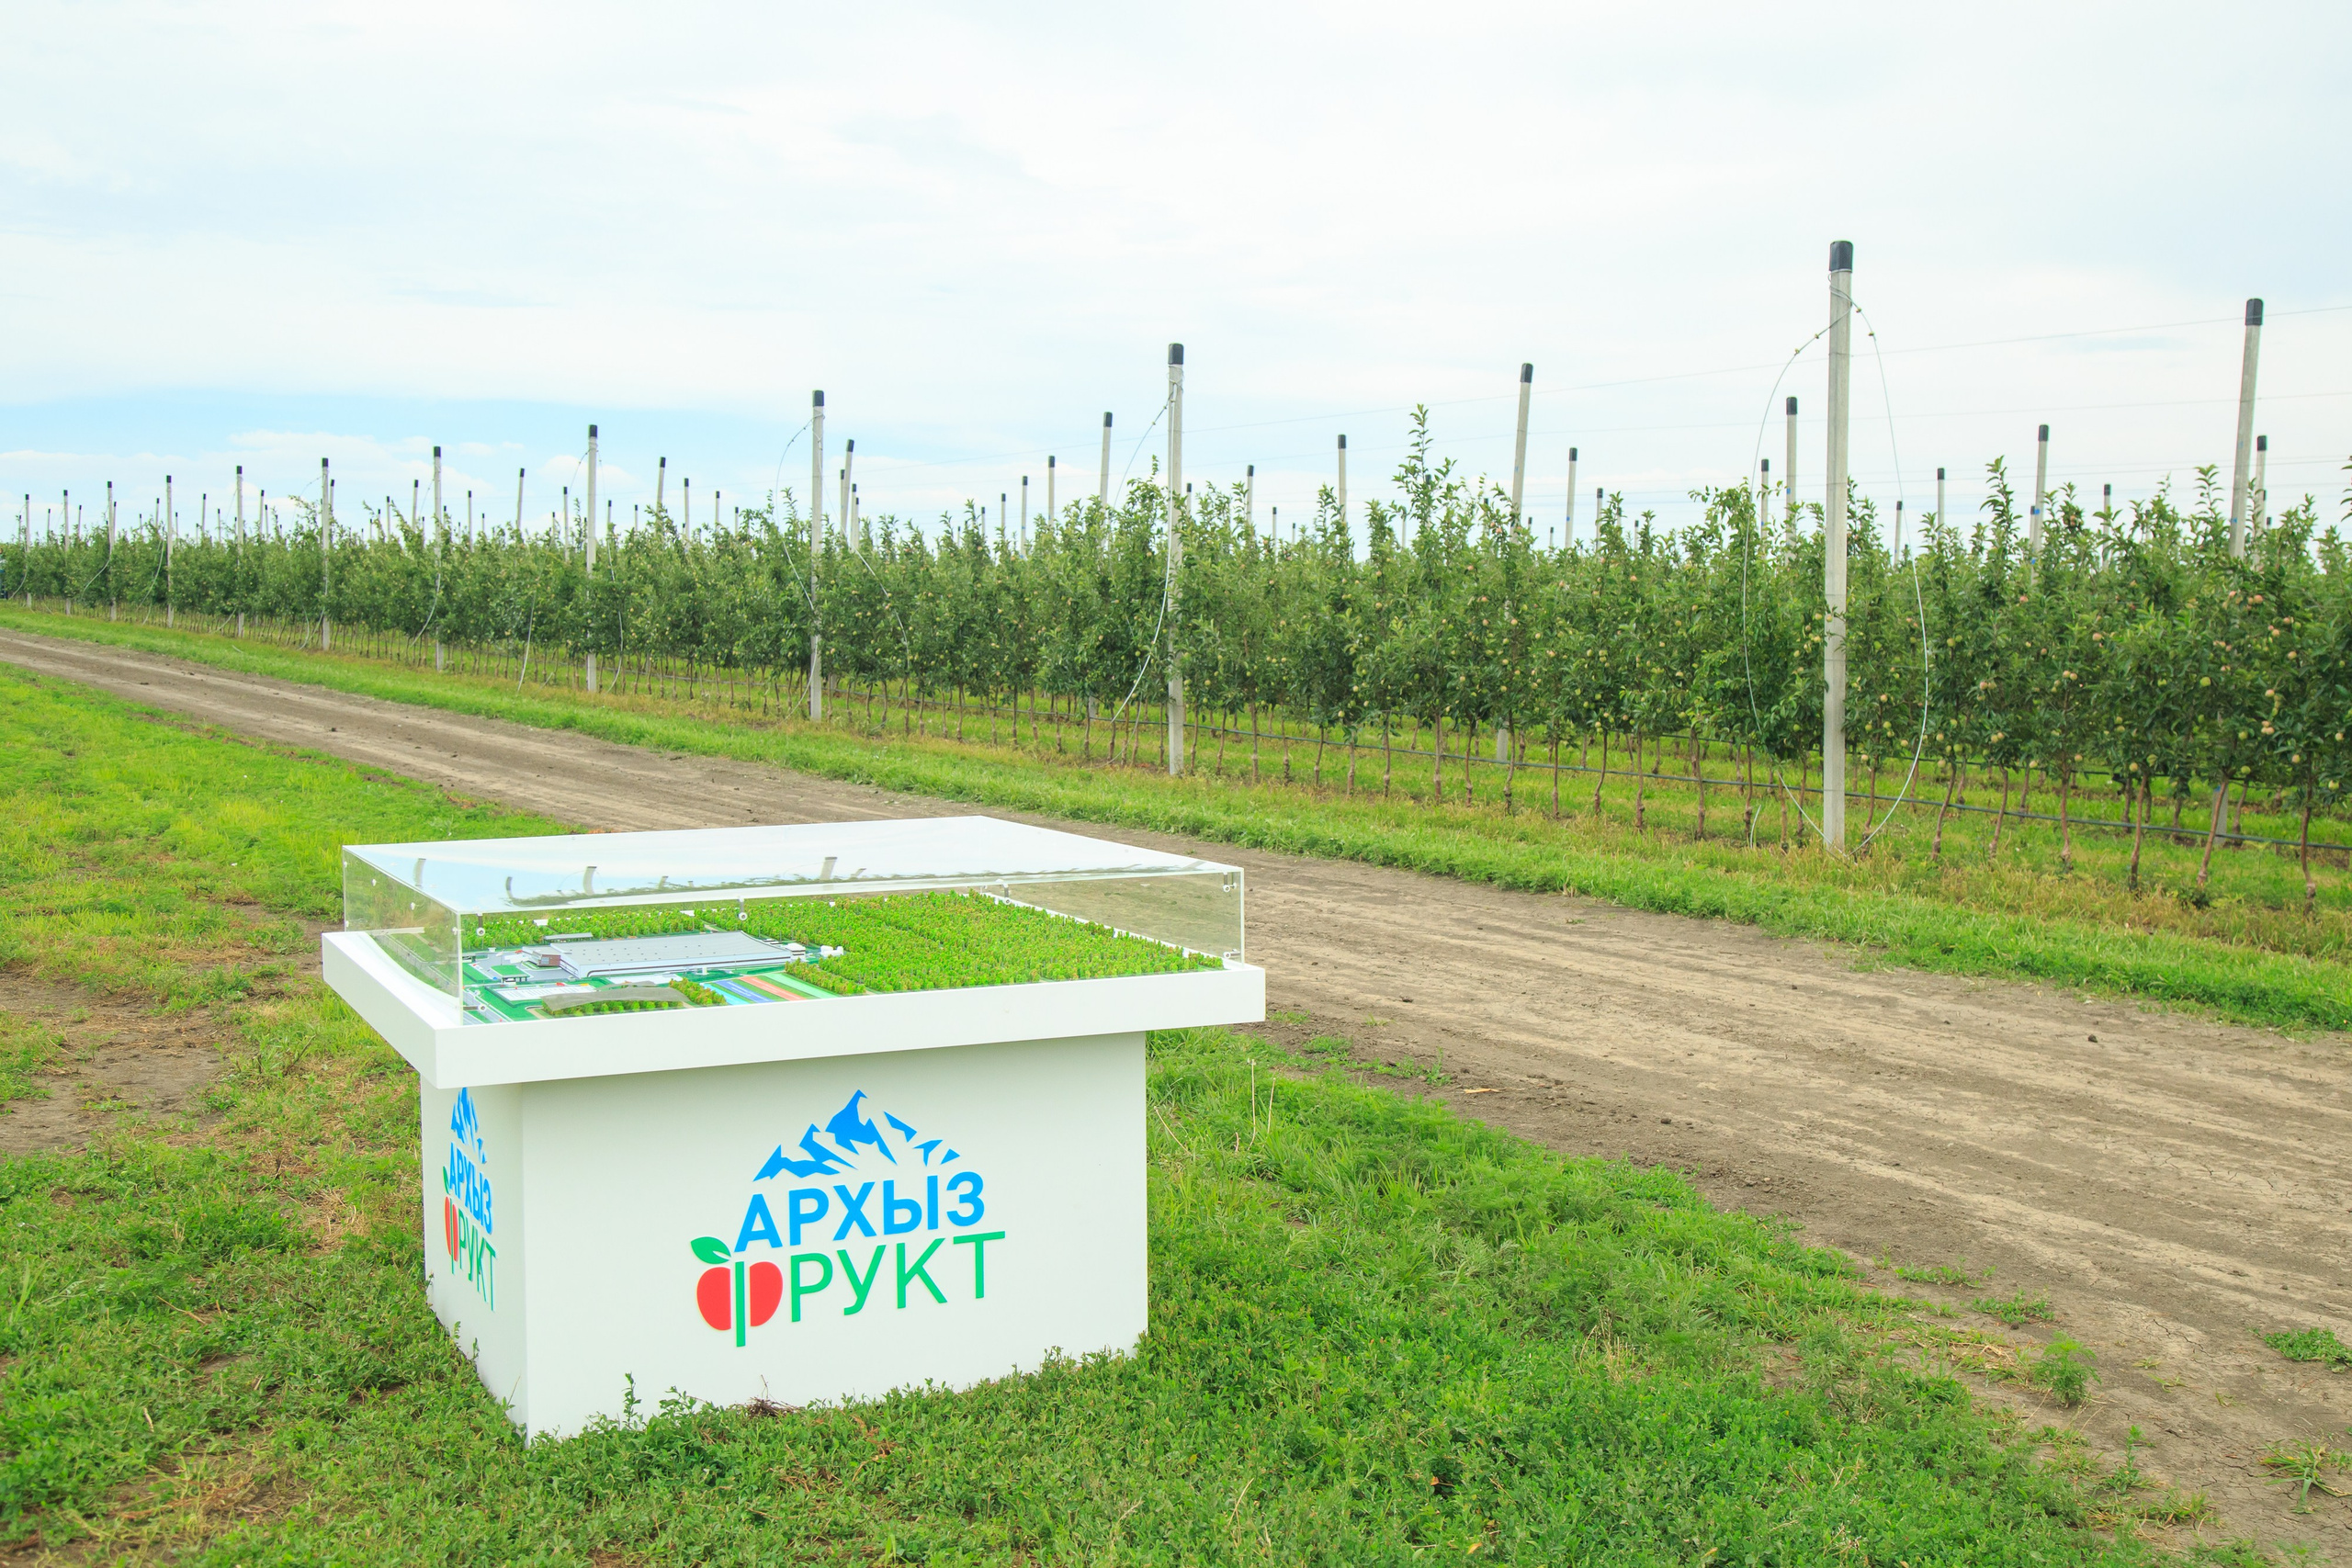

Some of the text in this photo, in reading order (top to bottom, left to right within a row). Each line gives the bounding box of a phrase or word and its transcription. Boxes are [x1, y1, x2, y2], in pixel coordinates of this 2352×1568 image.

[449, 1142, 492, 1234] АРХЫЗ
[734, 1171, 984, 1252] АРХЫЗ
[697, 1231, 1005, 1347] ФРУКТ
